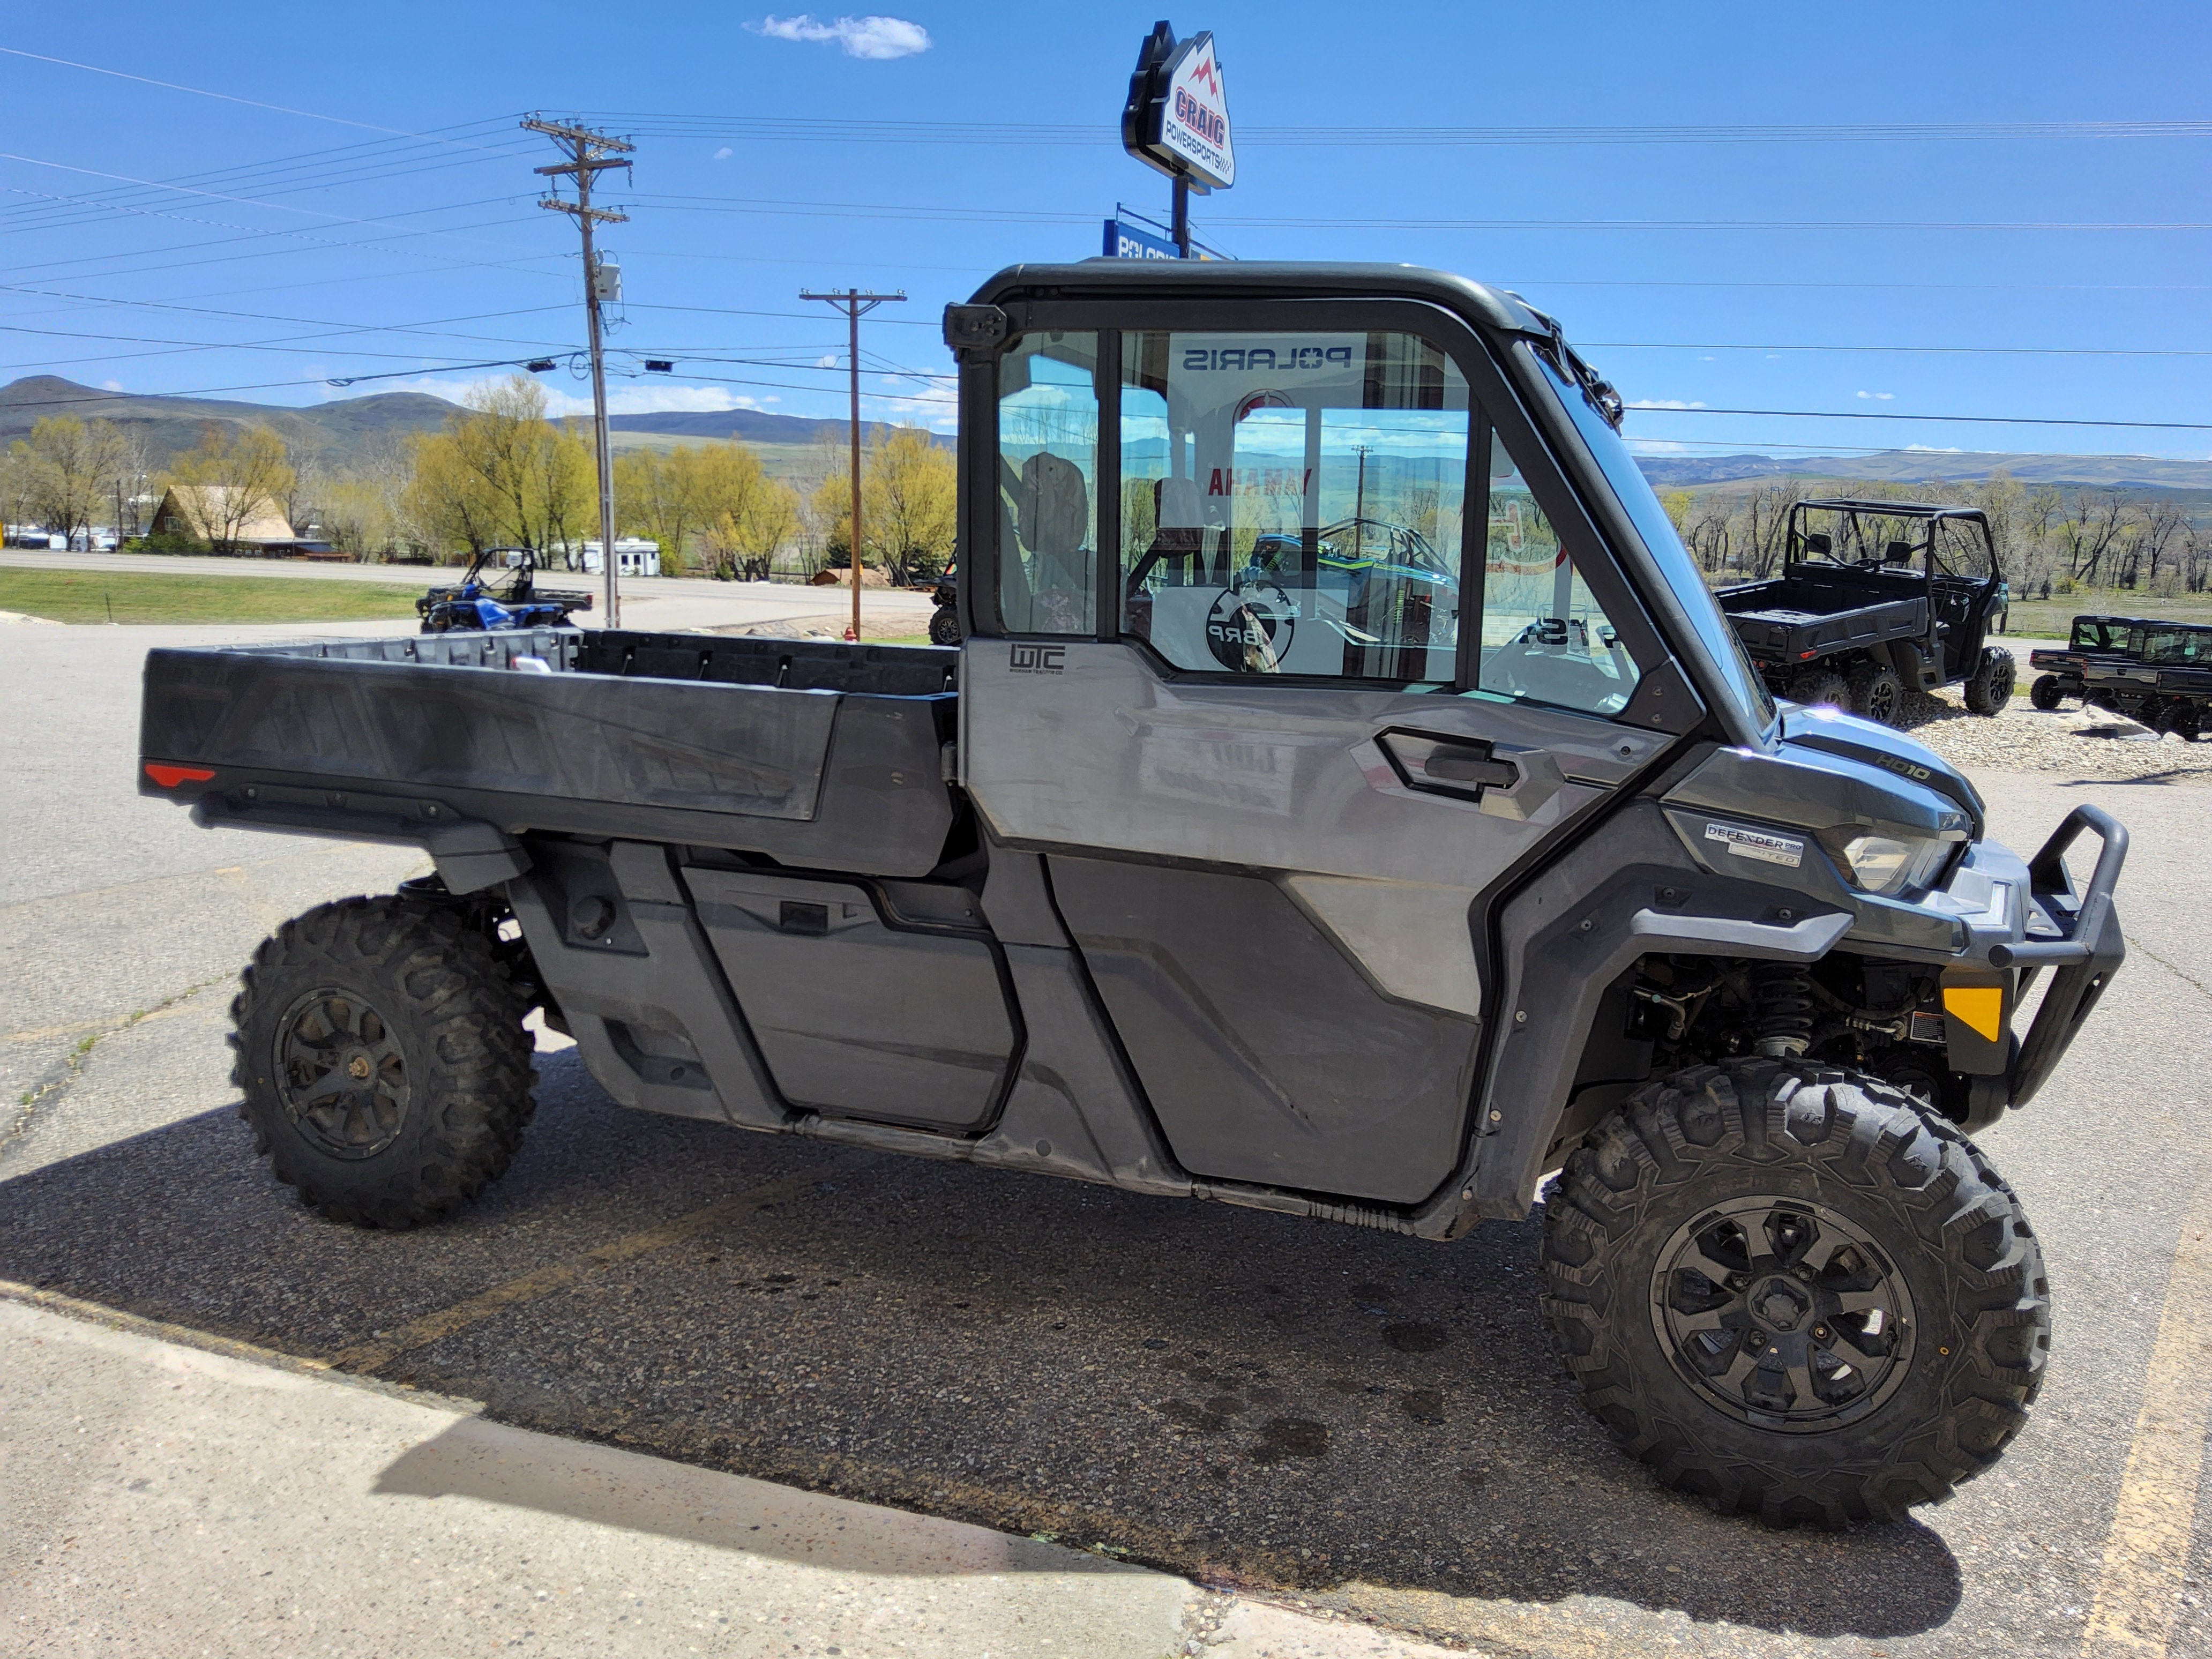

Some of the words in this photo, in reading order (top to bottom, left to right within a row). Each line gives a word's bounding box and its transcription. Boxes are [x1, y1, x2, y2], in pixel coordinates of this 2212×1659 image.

[1175, 86, 1225, 150] CRAIG
[1165, 119, 1221, 169] POWERSPORTS
[1875, 753, 1931, 780] HD10
[1707, 826, 1784, 849] DEFENDER
[1784, 842, 1802, 850] PRO
[1734, 845, 1795, 863] ITED
